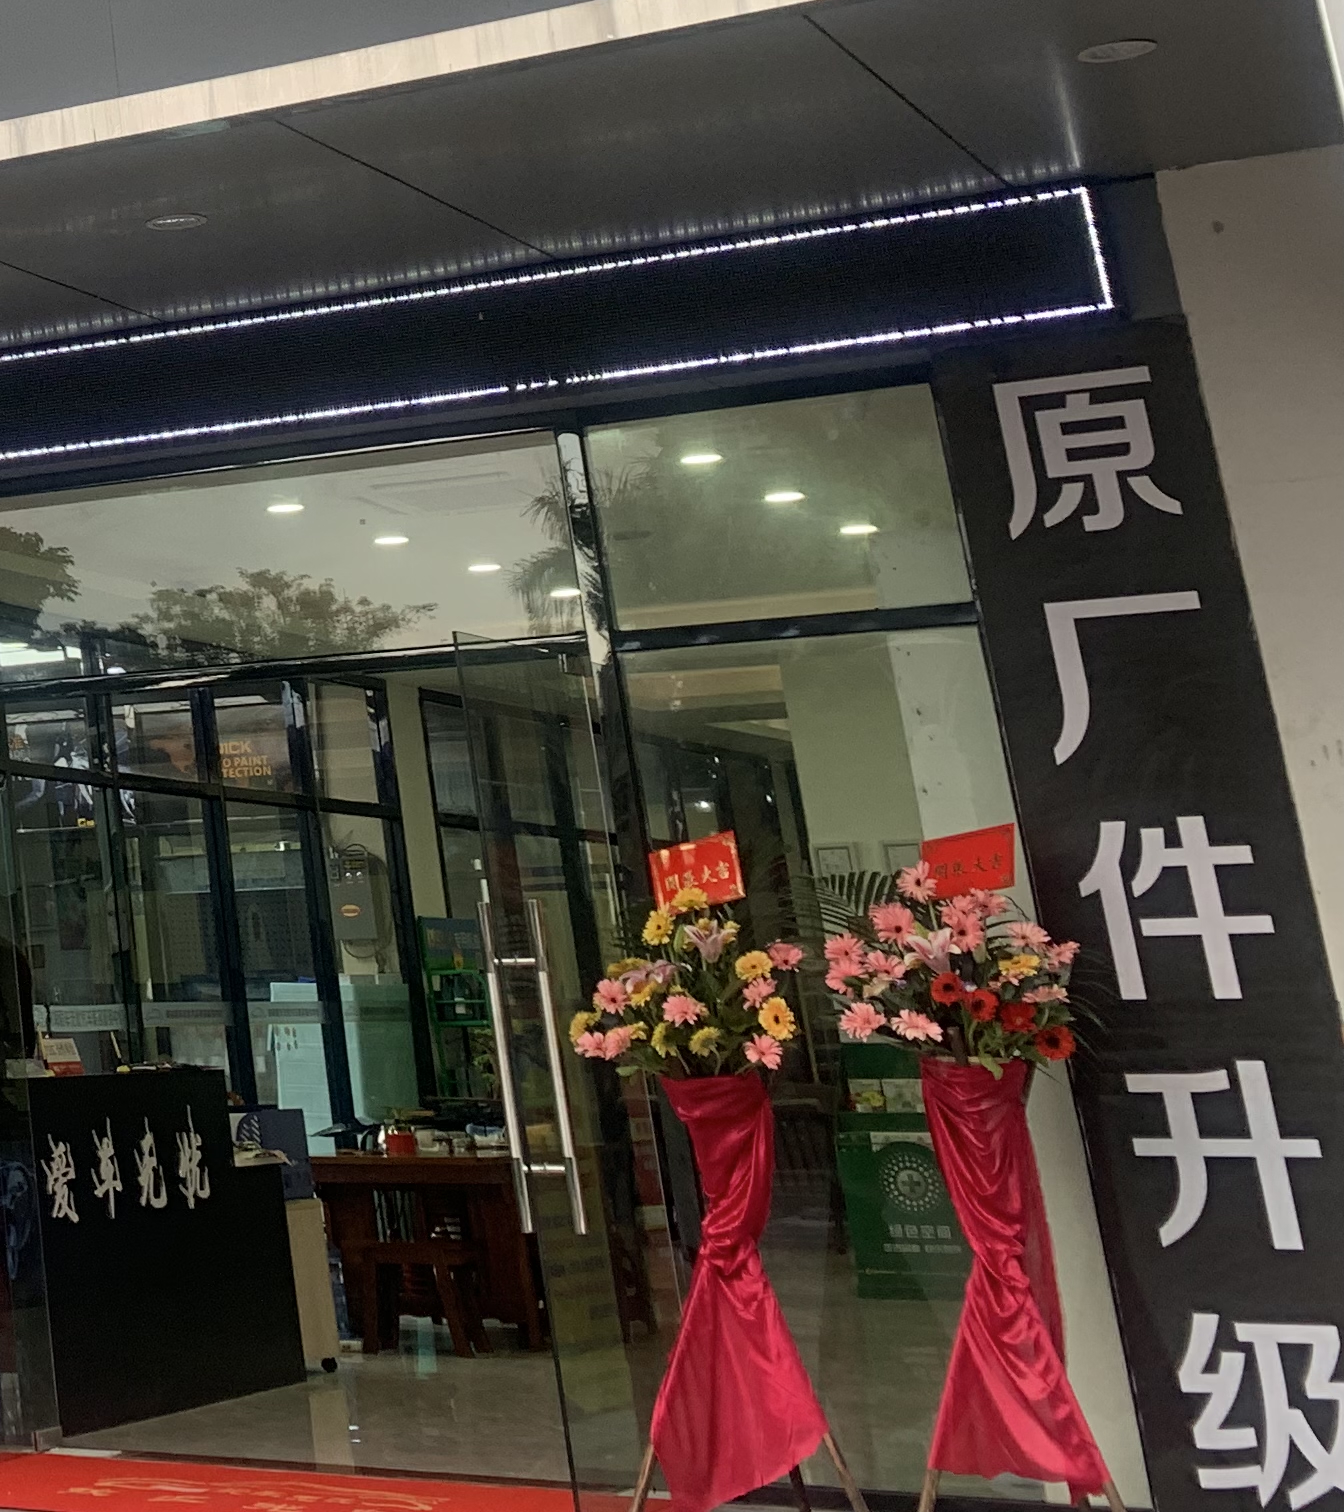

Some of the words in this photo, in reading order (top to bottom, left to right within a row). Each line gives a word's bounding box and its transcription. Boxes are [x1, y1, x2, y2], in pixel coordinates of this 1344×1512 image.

[234, 755, 269, 768] PAINT
[993, 366, 1344, 1512] 原厂件升级
